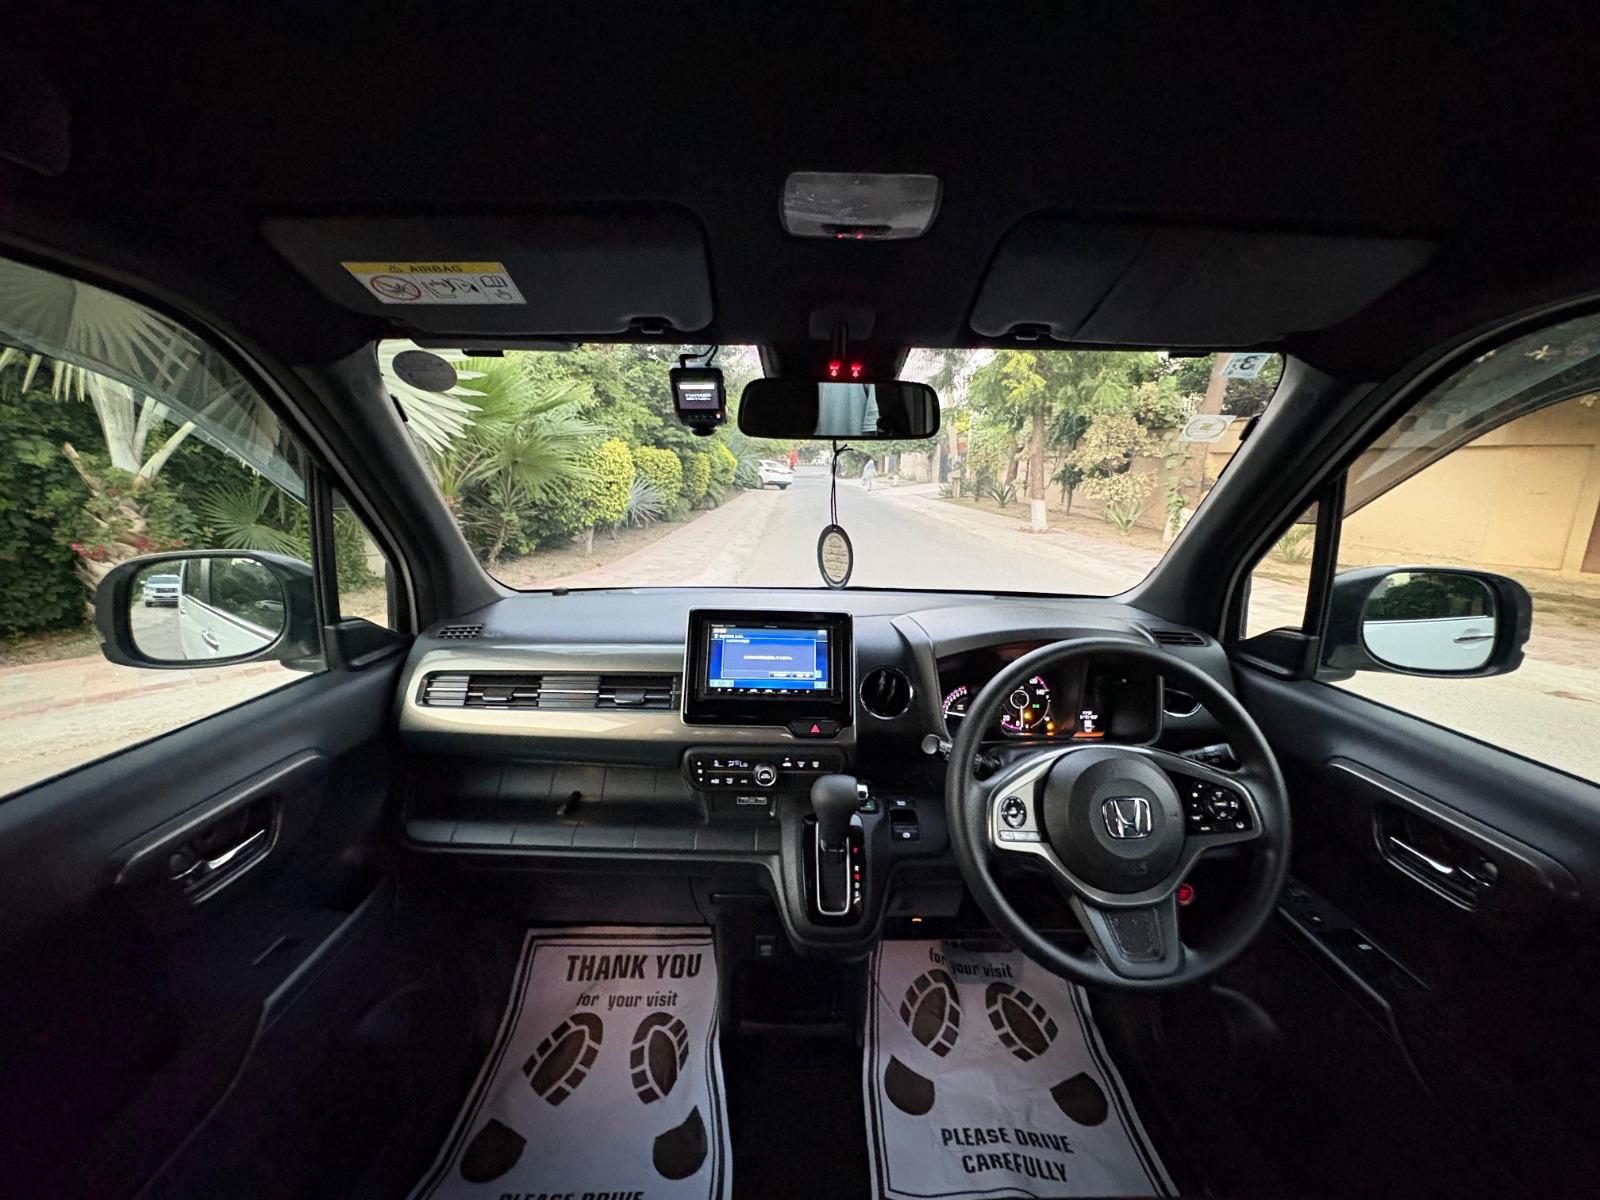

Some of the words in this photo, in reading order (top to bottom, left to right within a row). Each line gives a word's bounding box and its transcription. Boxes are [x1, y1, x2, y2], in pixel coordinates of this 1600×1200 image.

[409, 265, 464, 273] AIRBAG
[566, 955, 648, 981] THANK
[656, 953, 702, 979] YOU
[929, 947, 947, 966] for
[950, 961, 979, 974] your
[982, 963, 1013, 978] visit
[576, 992, 600, 1007] for
[608, 993, 643, 1010] your
[646, 991, 679, 1007] visit
[941, 1127, 1011, 1147] PLEASE
[1014, 1128, 1074, 1154] DRIVE
[961, 1152, 1068, 1182] CAREFULLY
